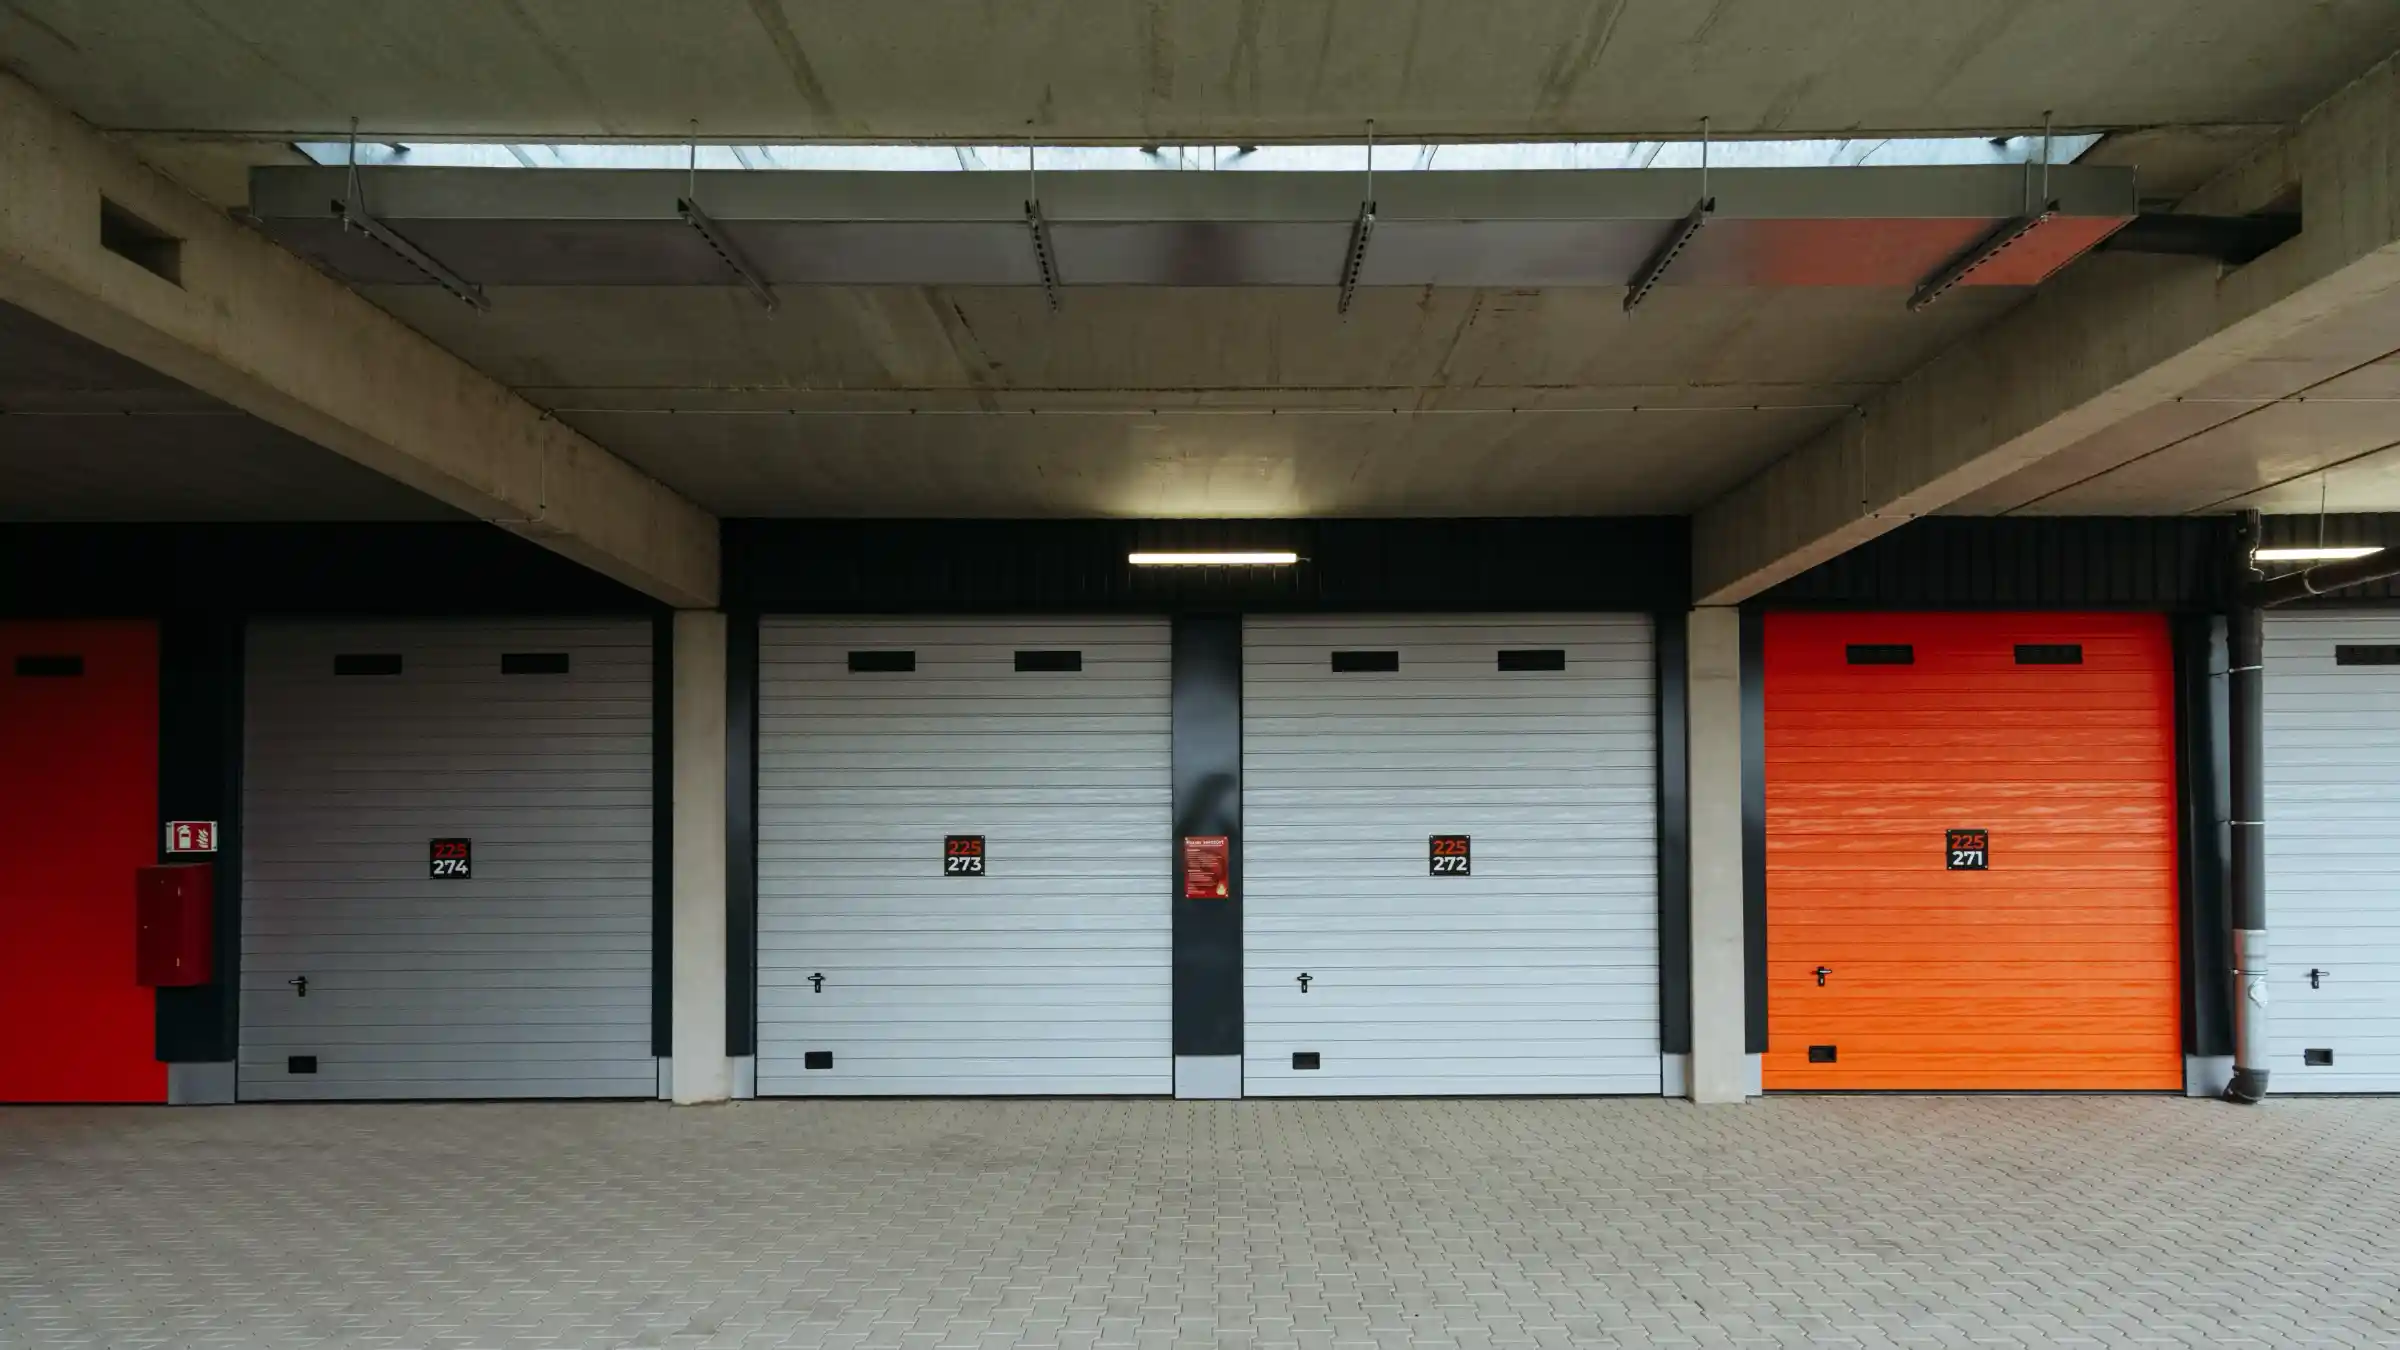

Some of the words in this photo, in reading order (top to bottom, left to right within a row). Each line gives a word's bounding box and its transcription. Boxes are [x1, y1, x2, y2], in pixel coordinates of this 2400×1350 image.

[948, 840, 982, 855] 225
[1433, 840, 1467, 855] 225
[1951, 834, 1985, 850] 225
[434, 843, 467, 859] 225
[1952, 850, 1983, 865] 271
[433, 859, 468, 874] 274
[948, 856, 982, 871] 273
[1433, 856, 1467, 871] 272
